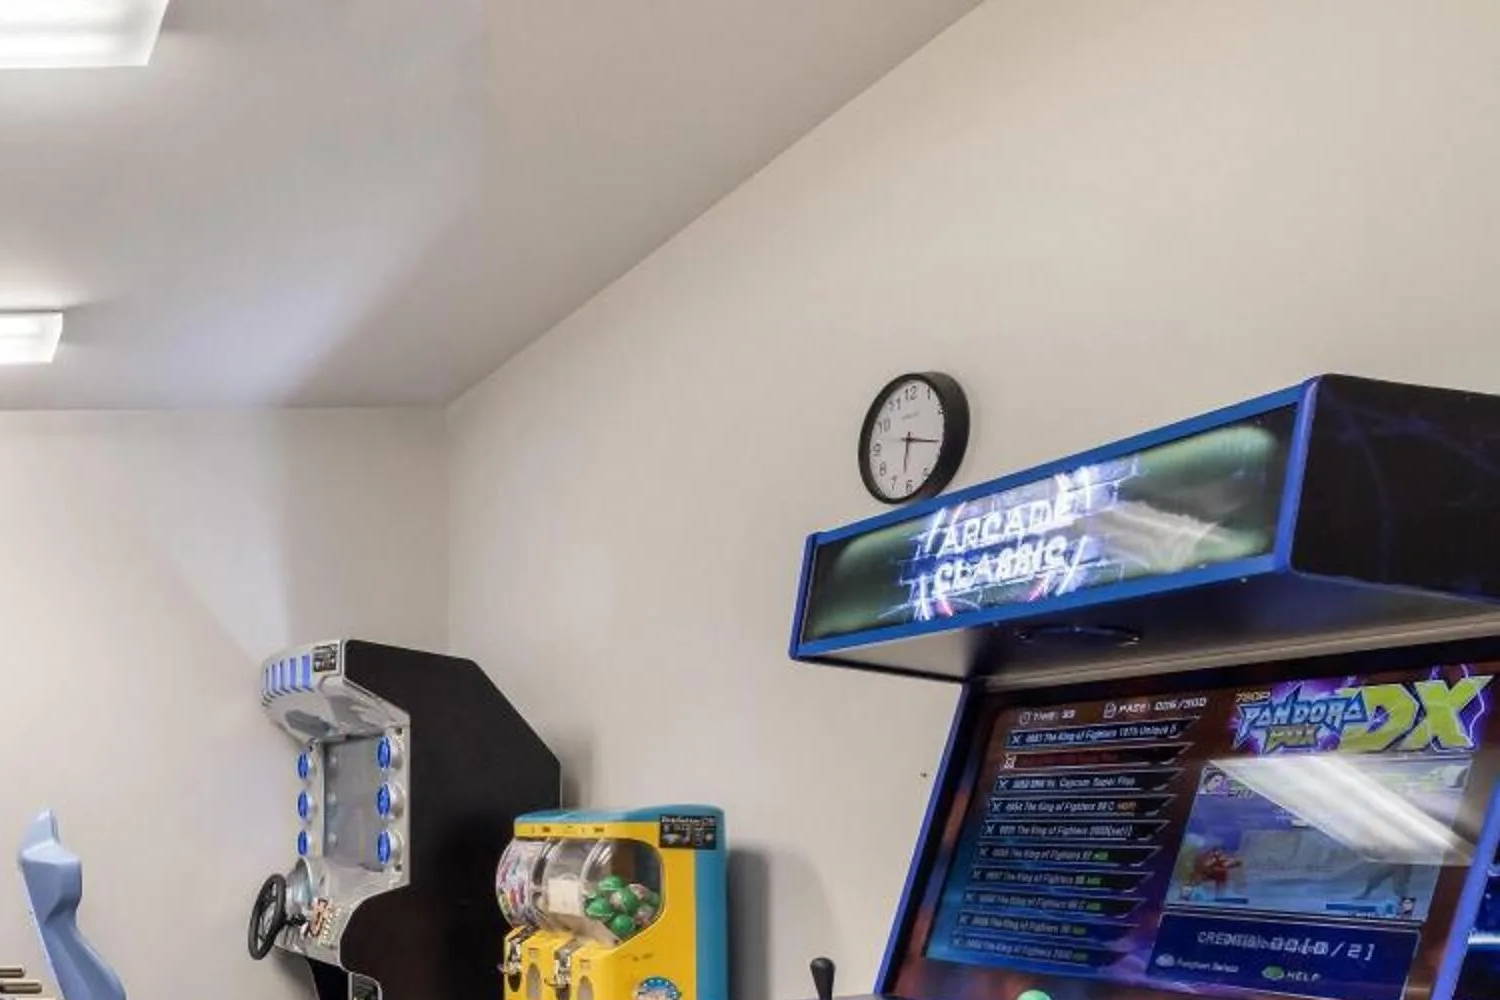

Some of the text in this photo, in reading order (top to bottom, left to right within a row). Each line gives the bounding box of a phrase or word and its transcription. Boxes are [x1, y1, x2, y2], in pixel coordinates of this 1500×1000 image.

[904, 385, 918, 401] 12
[877, 419, 891, 434] 10
[936, 490, 1080, 560] ARCADE
[933, 535, 1069, 595] CLASSIC
[1238, 675, 1494, 752] PANDORA DX
[1286, 971, 1321, 983] HELP
